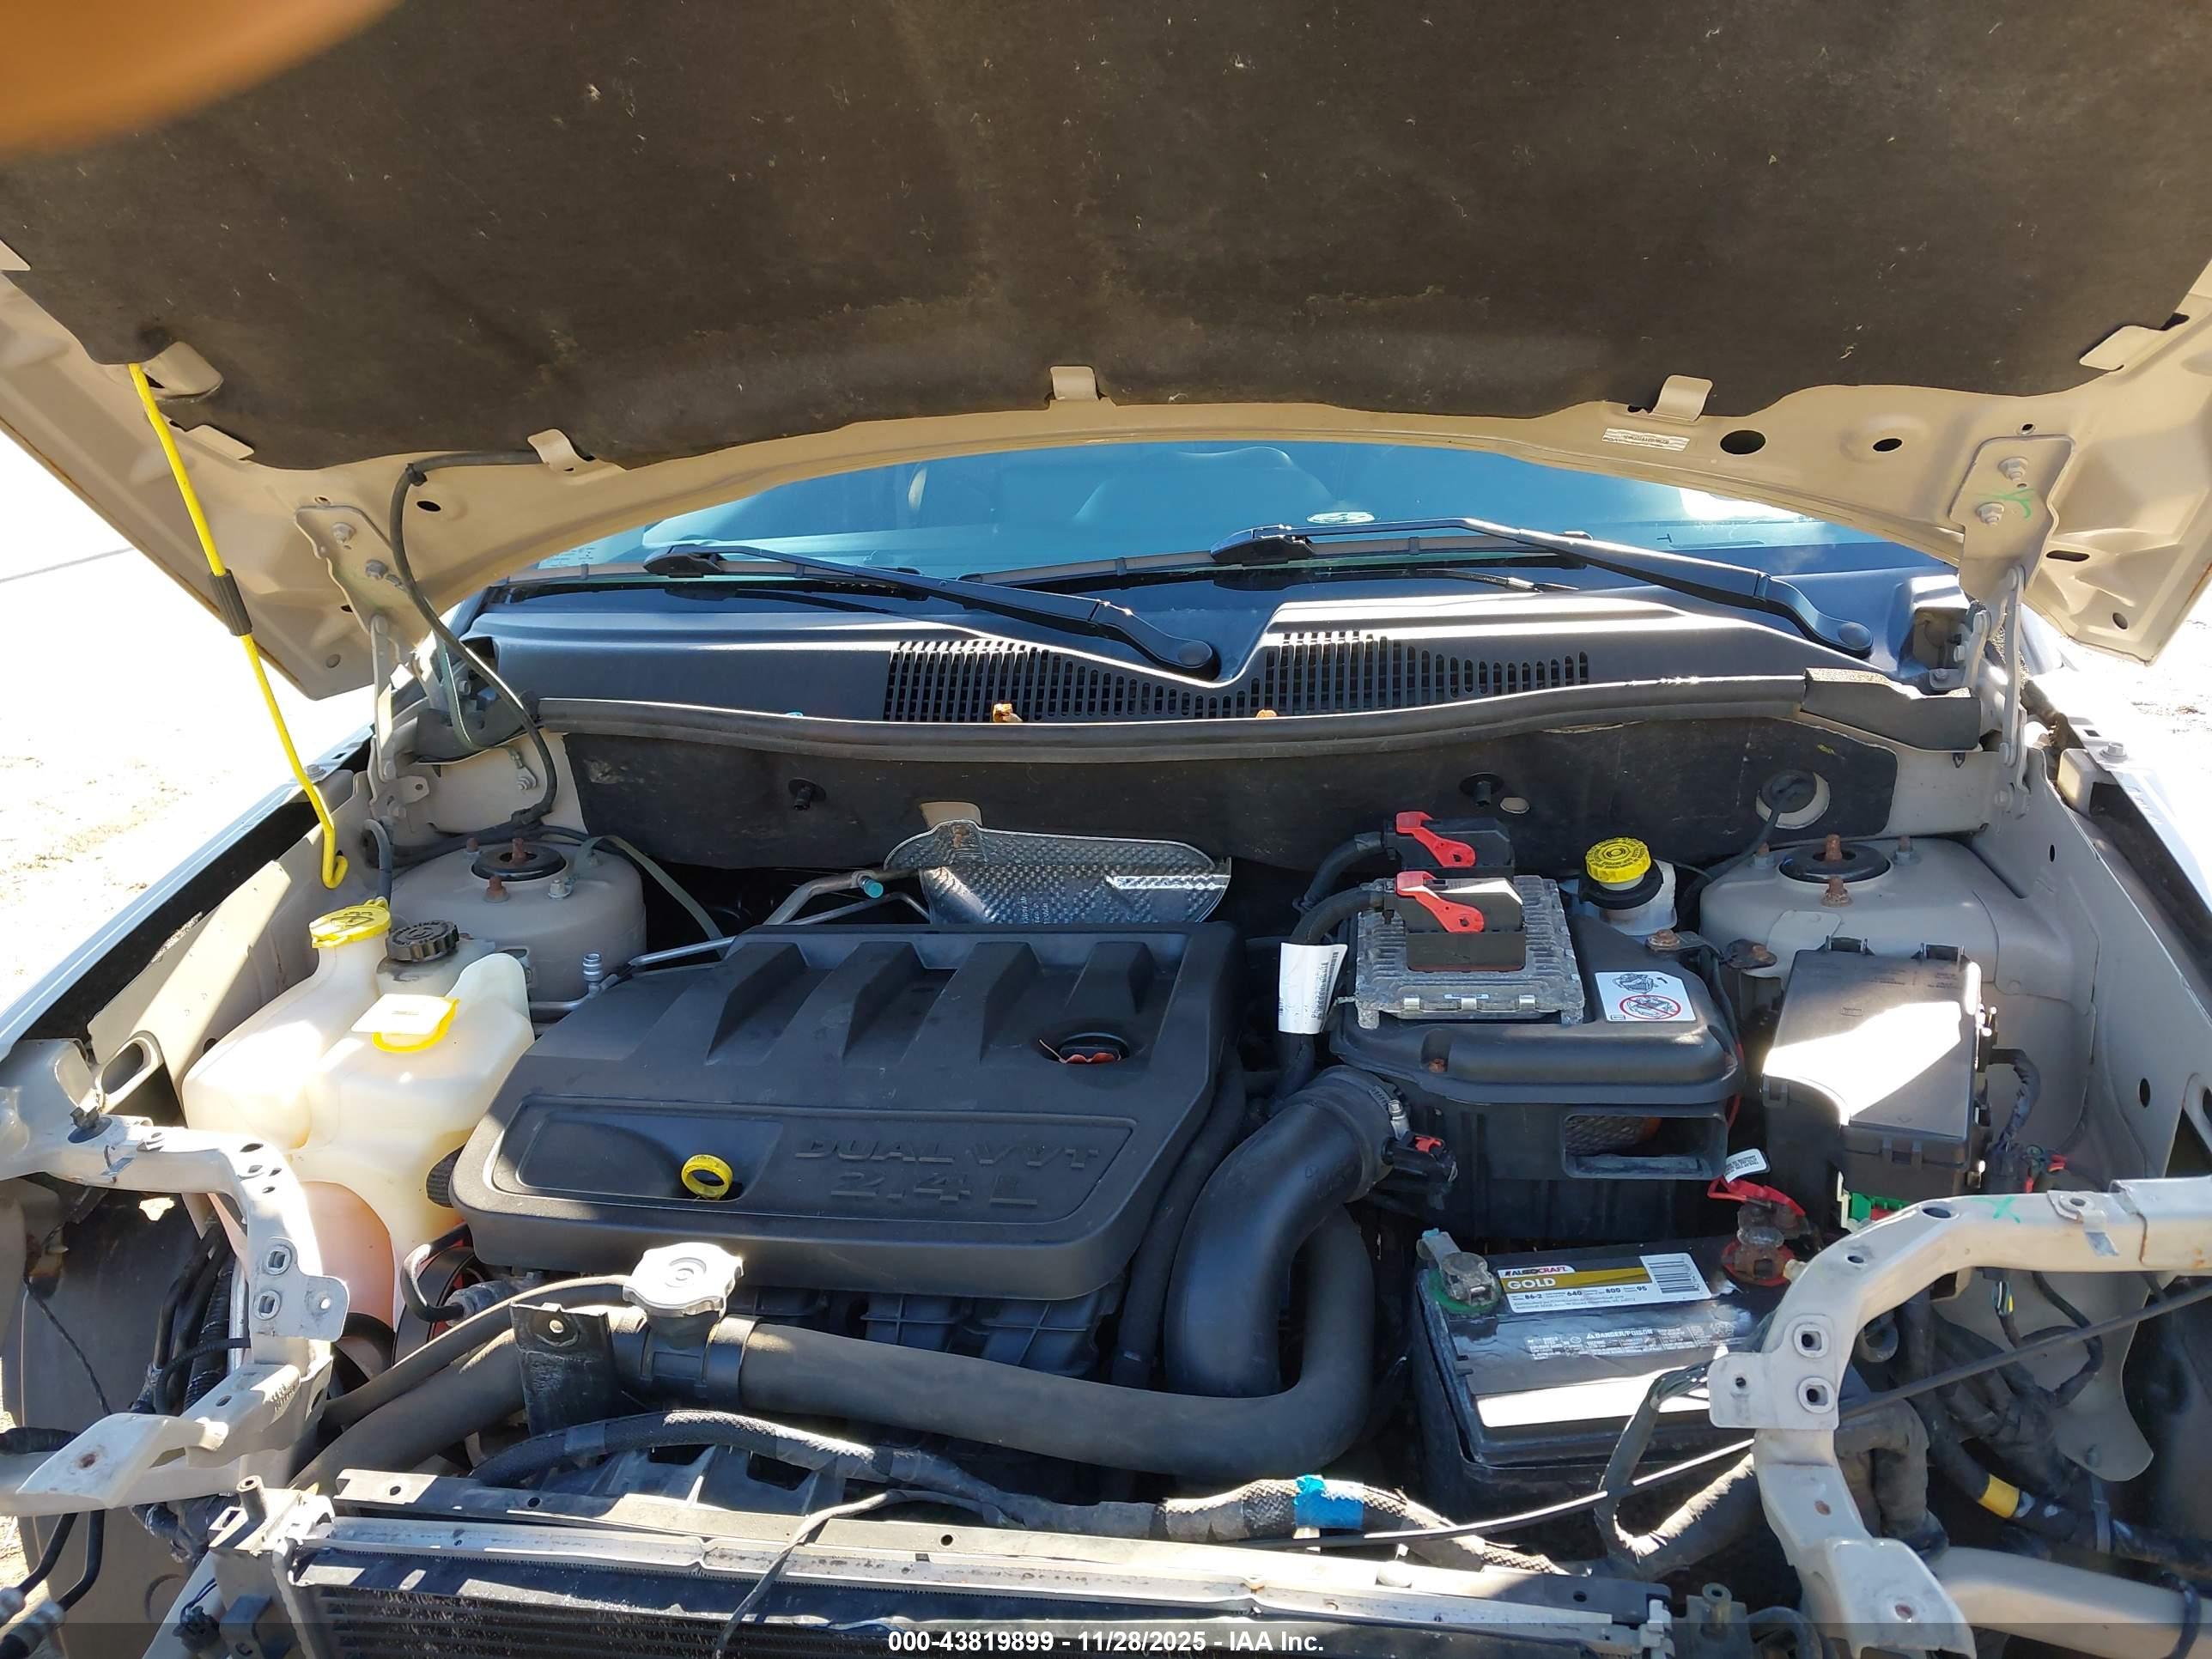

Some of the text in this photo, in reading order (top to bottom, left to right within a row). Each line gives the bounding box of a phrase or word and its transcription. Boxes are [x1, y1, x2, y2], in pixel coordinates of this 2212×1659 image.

[794, 1139, 1100, 1170] DUAL VVT
[1507, 1278, 1557, 1291] GOLD
